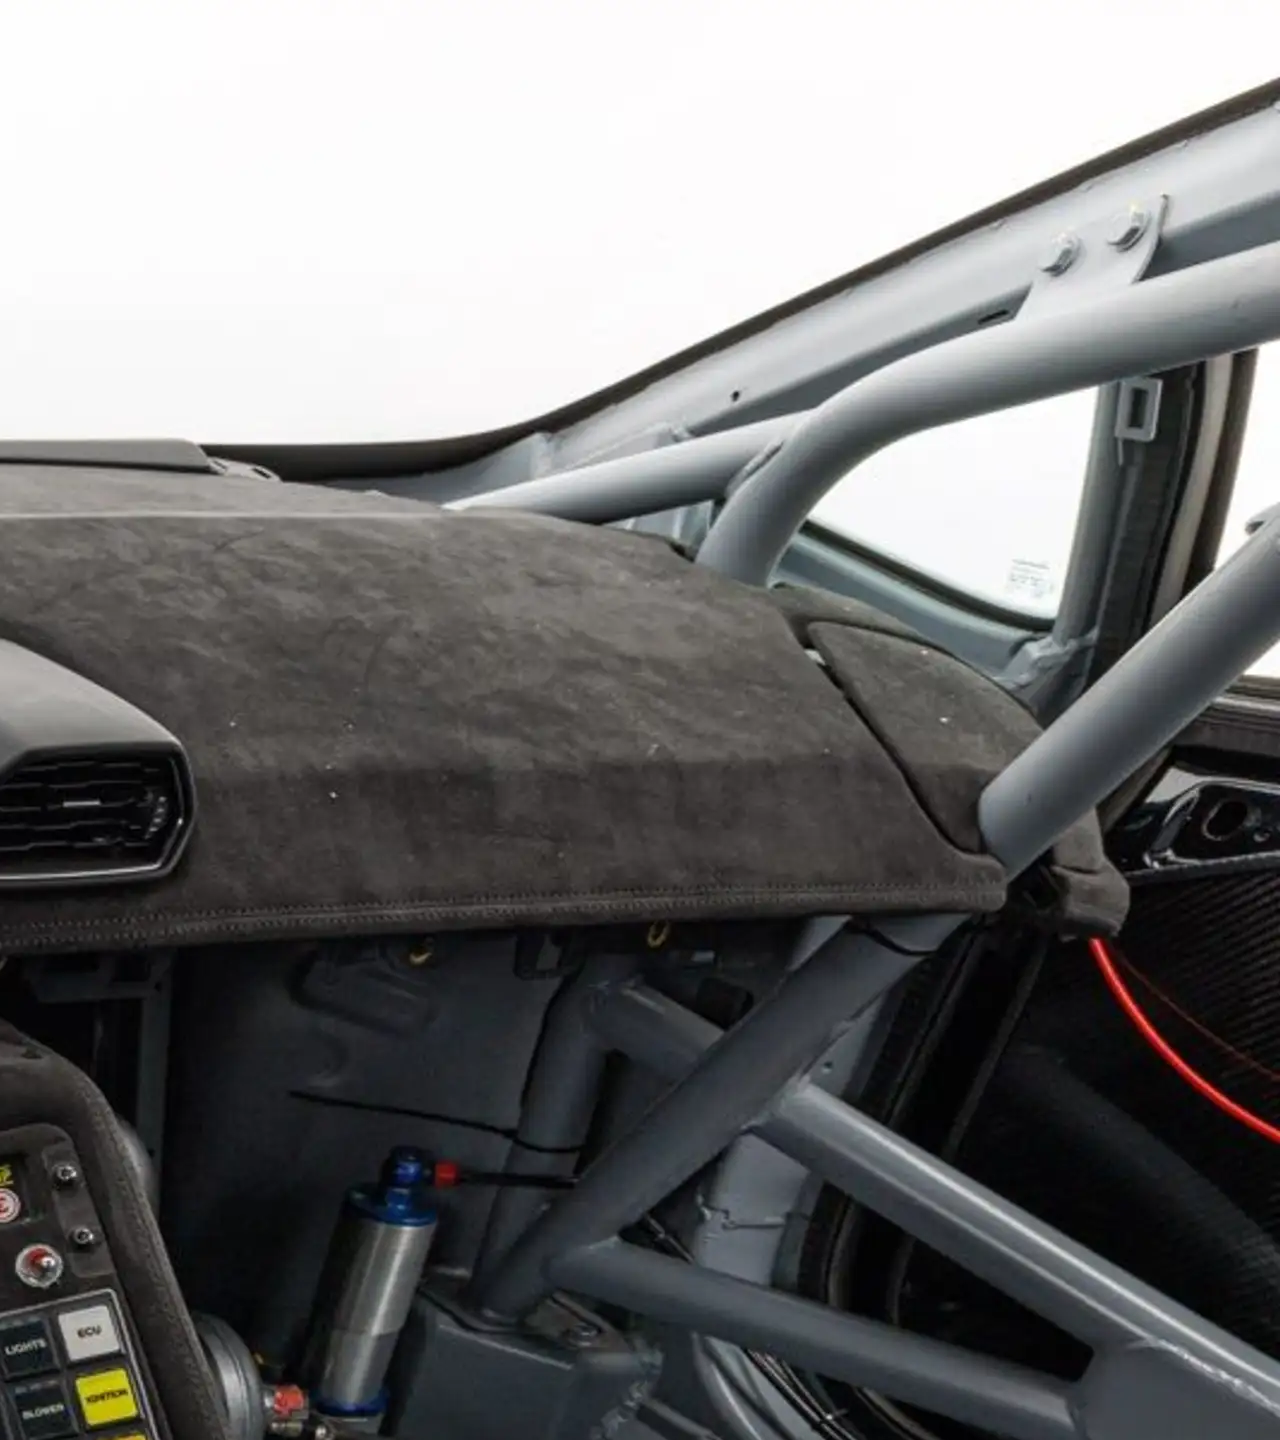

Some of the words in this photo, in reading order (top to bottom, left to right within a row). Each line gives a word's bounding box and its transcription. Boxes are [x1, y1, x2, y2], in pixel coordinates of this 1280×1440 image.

[77, 1324, 103, 1340] ECU
[4, 1337, 47, 1356] LIGHTS
[21, 1403, 66, 1420] BLOWER
